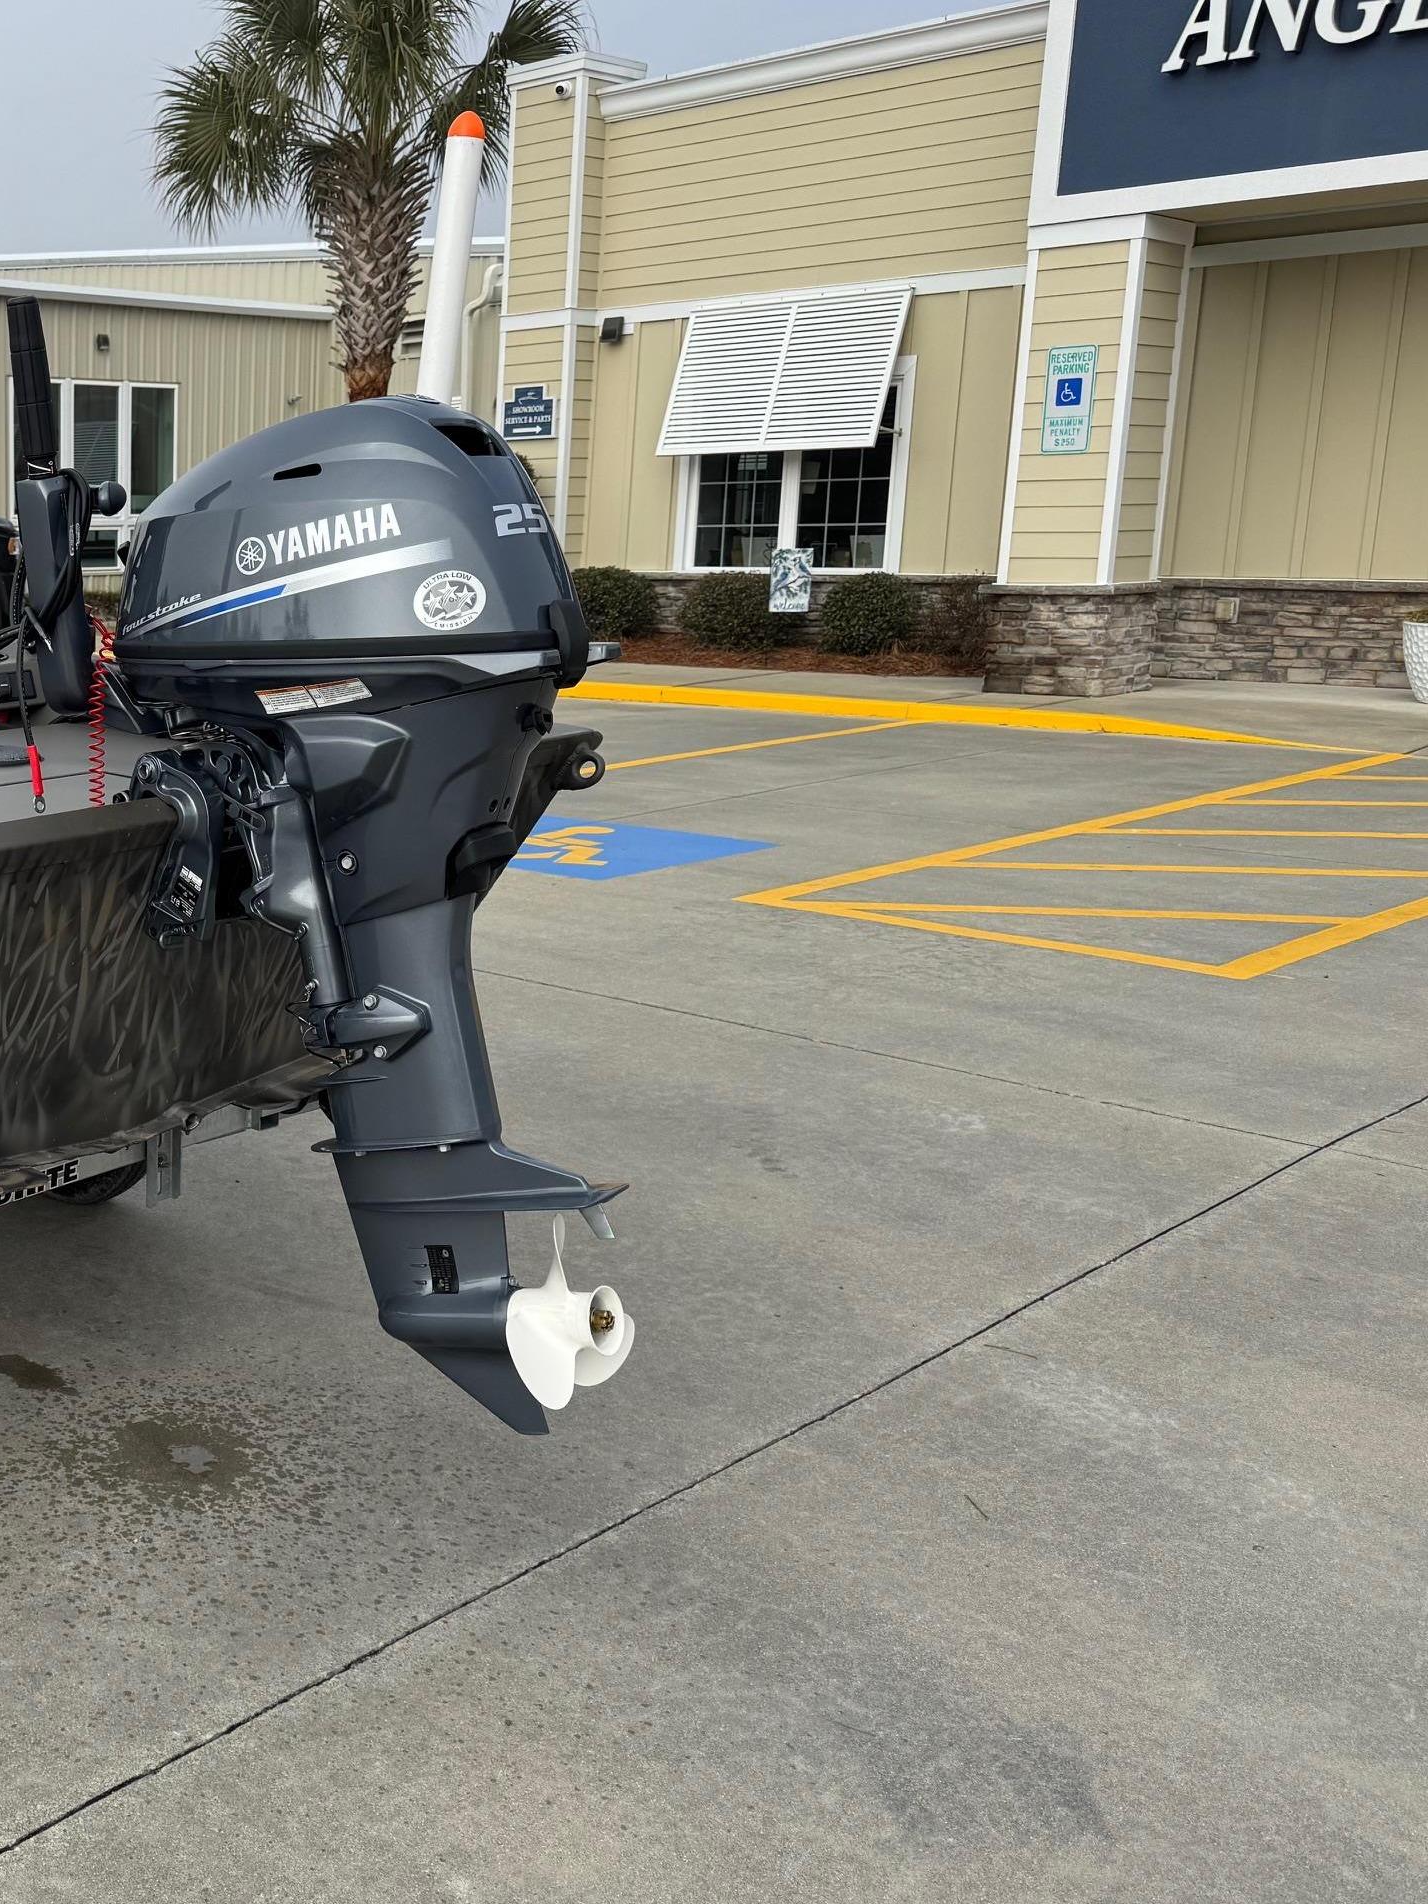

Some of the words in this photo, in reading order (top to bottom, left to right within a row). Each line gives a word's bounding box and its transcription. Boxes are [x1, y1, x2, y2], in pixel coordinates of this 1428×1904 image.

[1051, 351, 1093, 364] RESERVED
[1052, 363, 1090, 375] PARKING
[1049, 418, 1084, 428] MAXIMUM
[1050, 428, 1081, 437] PENALTY
[492, 503, 548, 537] 25
[267, 503, 402, 565] YAMAHA
[423, 573, 449, 590] ULTRA
[451, 572, 472, 581] LOW
[434, 616, 474, 628] EMISSION
